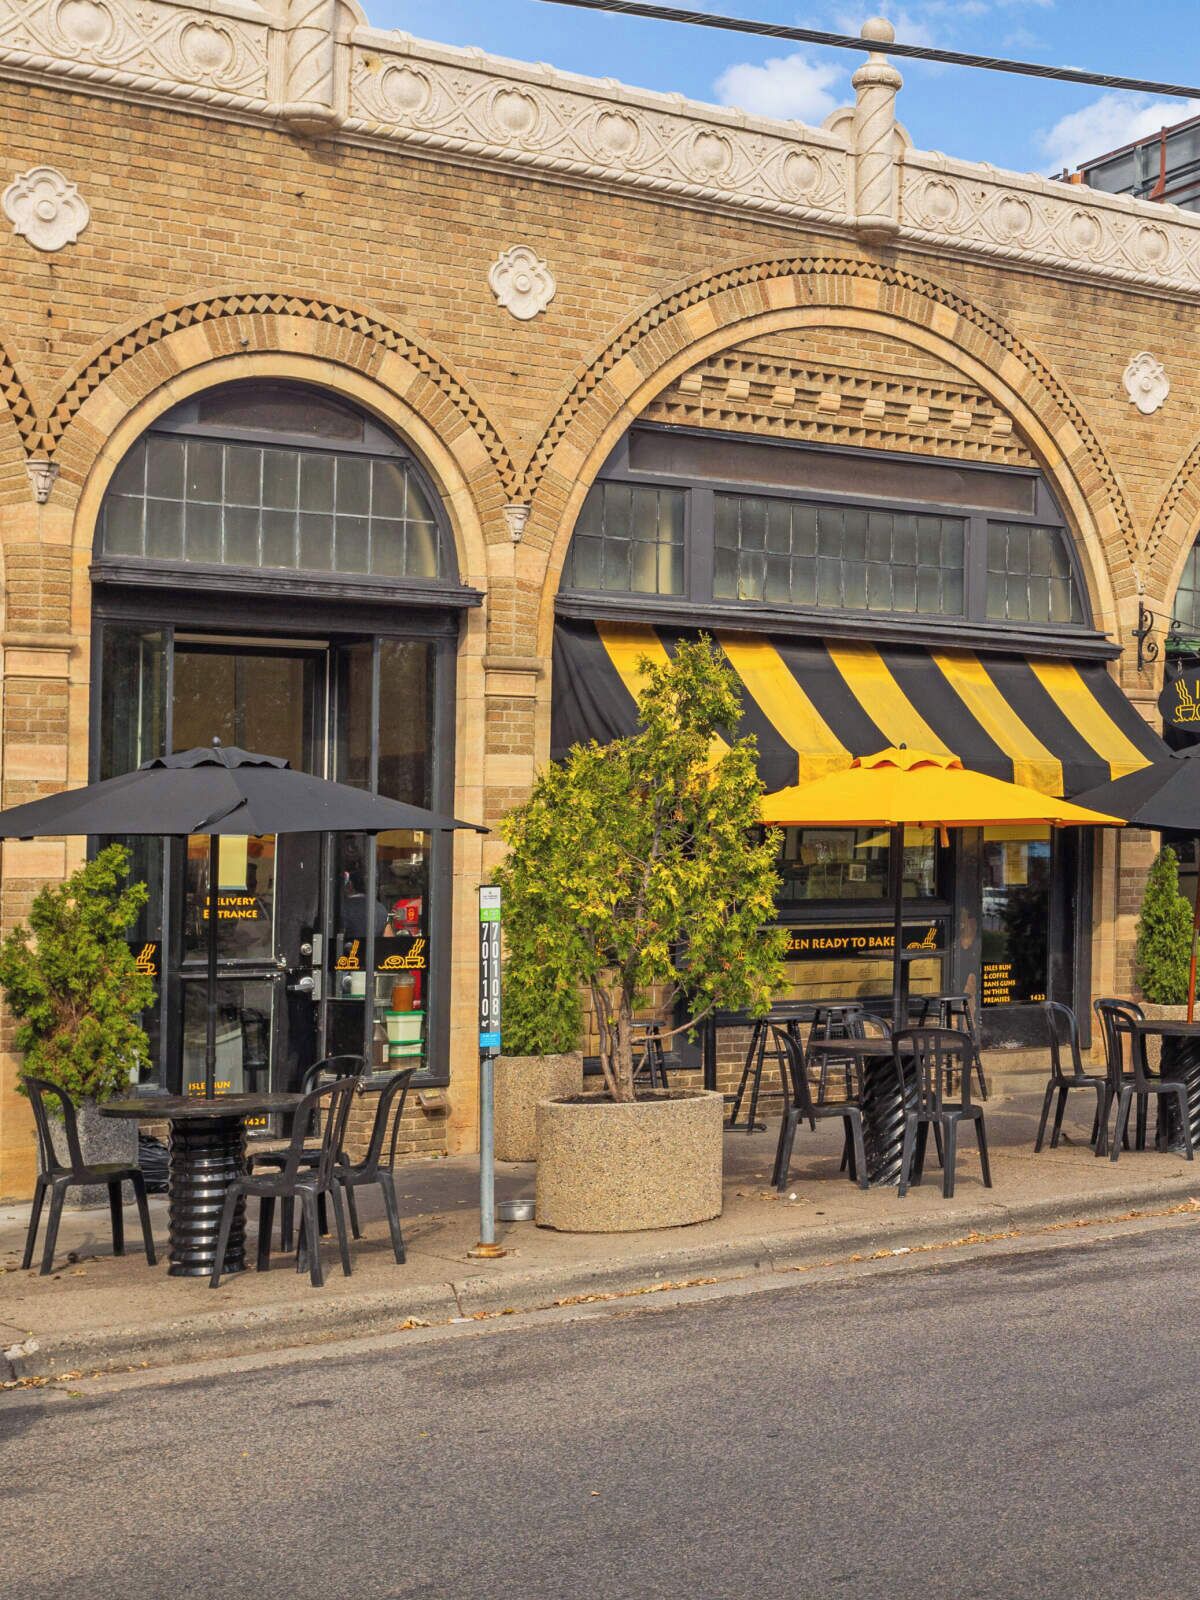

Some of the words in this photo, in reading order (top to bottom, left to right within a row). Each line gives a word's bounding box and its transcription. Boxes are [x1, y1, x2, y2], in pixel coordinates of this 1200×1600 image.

[203, 909, 258, 919] ETRANCE
[784, 938, 809, 950] ZEN
[812, 937, 849, 949] READY
[850, 936, 866, 948] TO
[868, 936, 896, 947] BAKE
[1000, 979, 1016, 987] GUNS
[188, 1082, 207, 1090] ISLE
